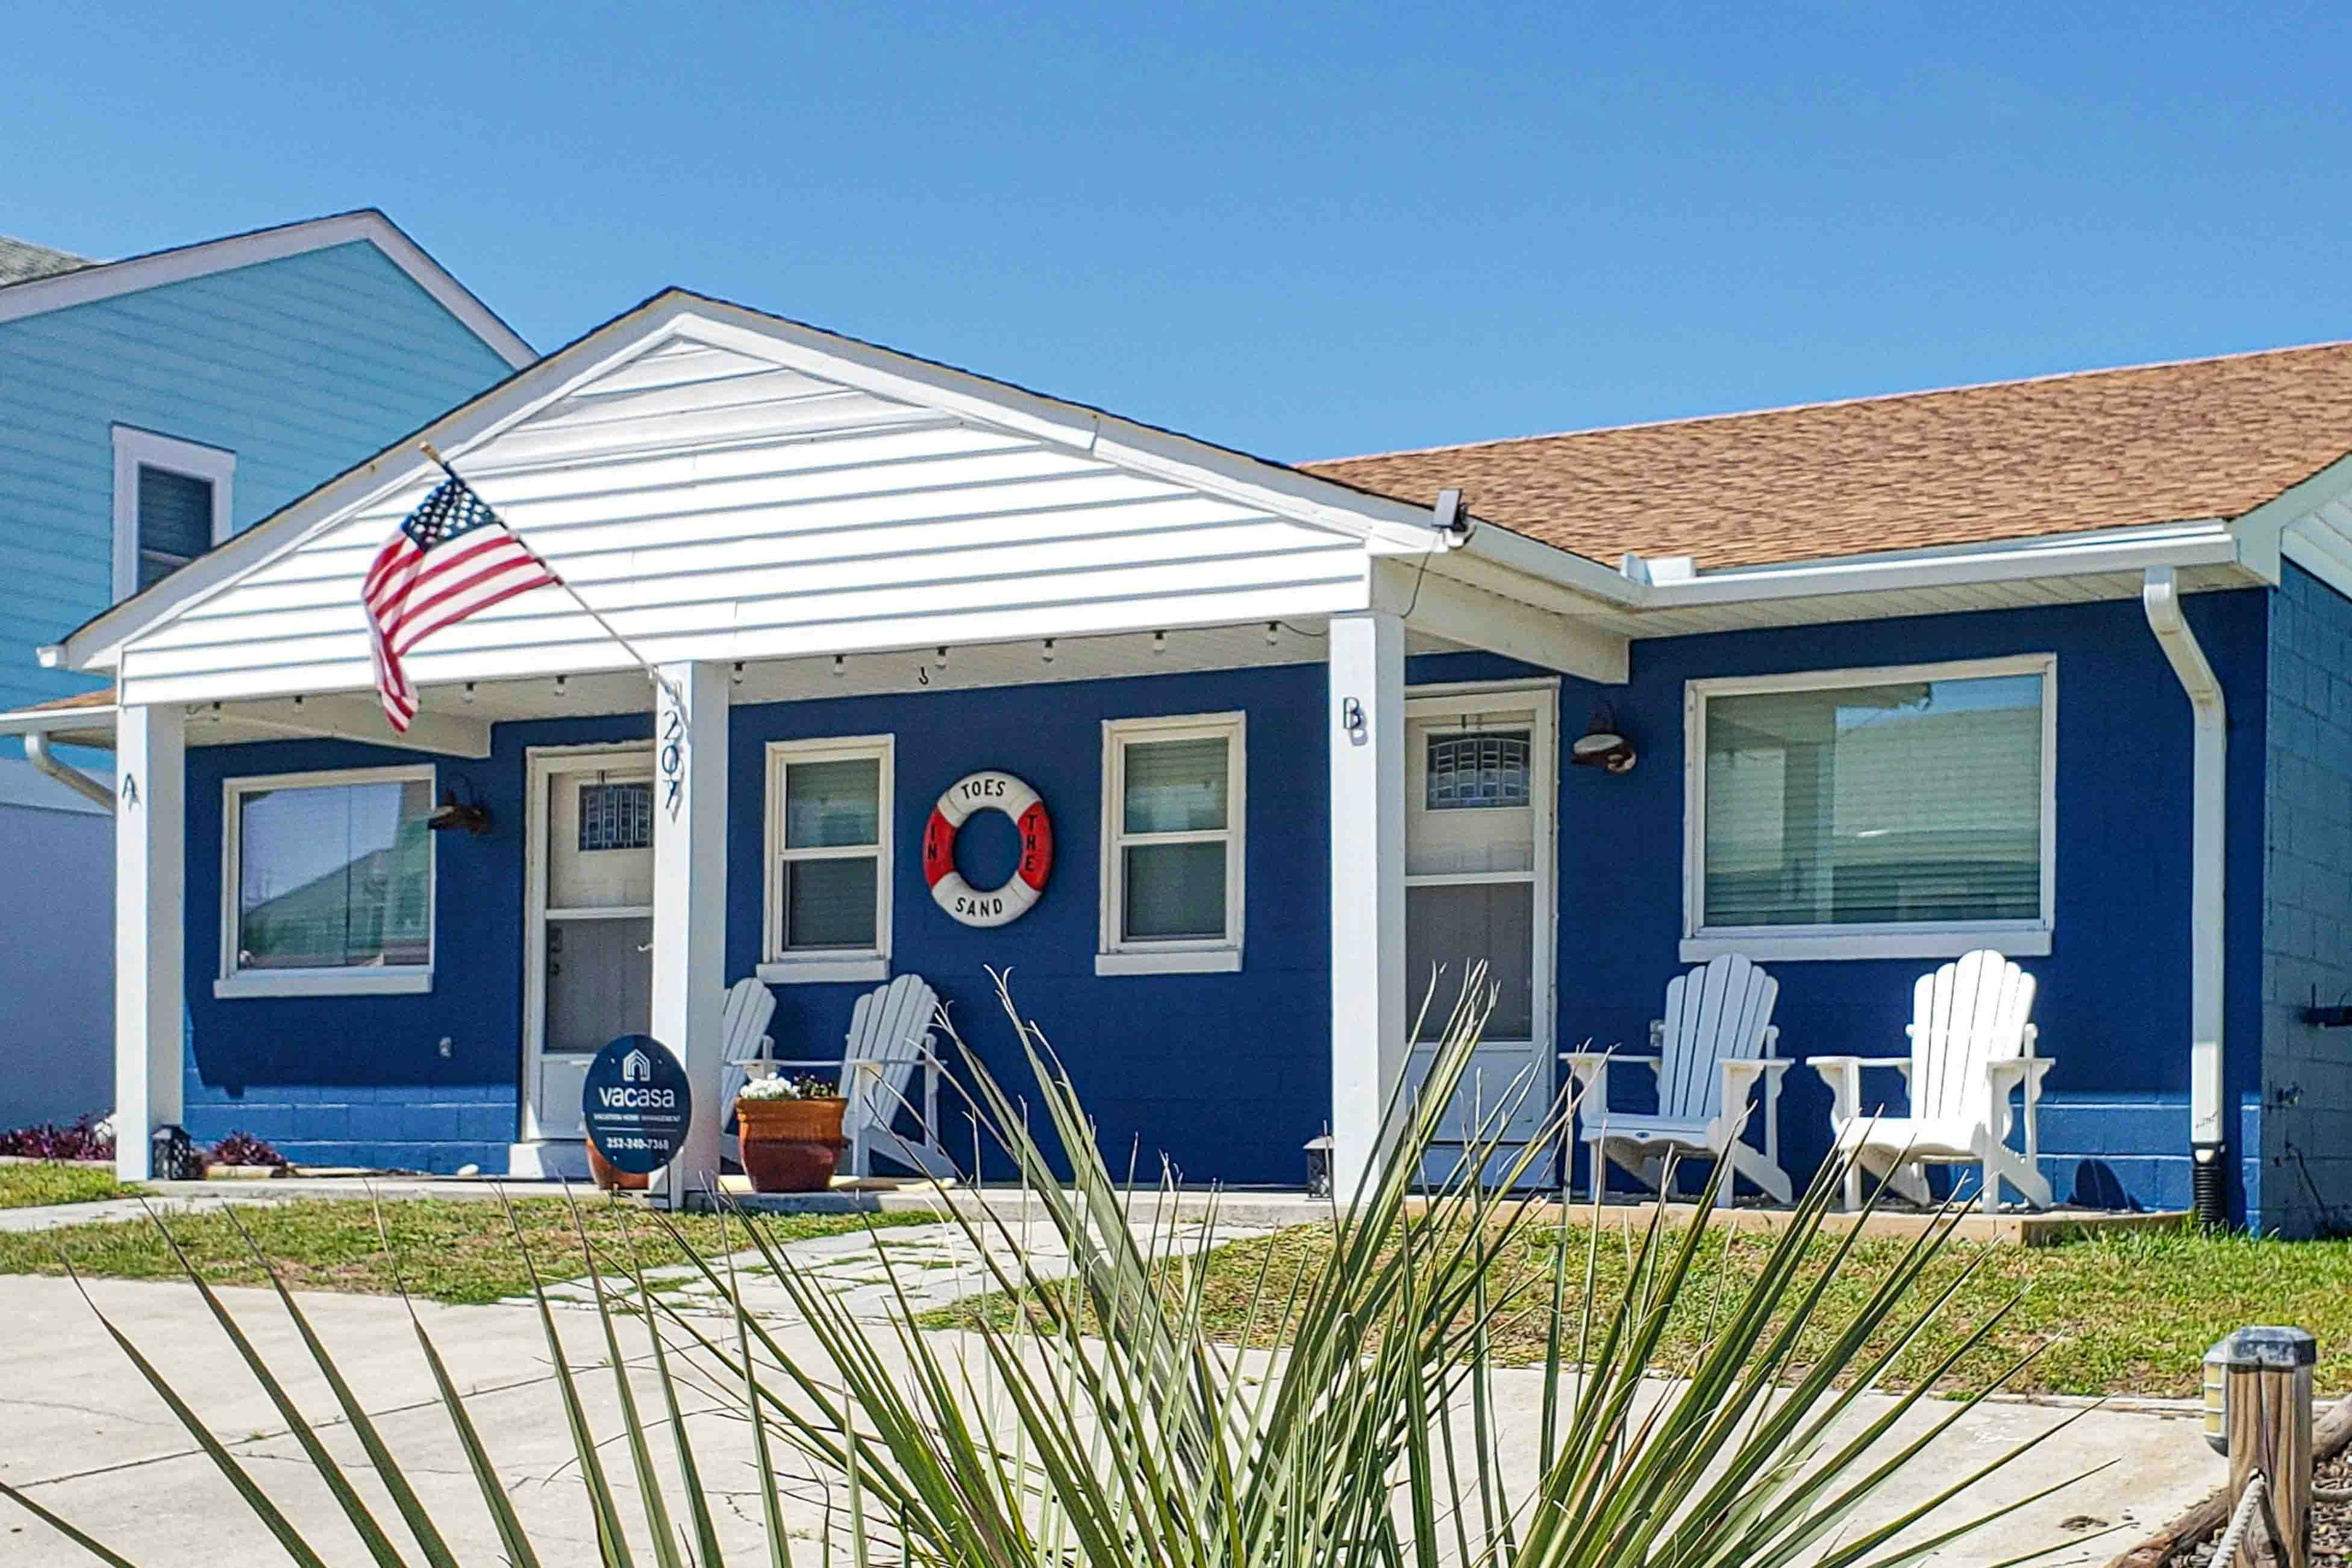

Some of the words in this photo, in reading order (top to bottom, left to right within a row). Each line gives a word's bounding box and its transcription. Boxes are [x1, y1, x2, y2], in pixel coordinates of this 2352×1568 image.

[1343, 697, 1361, 729] B
[122, 773, 136, 800] A
[960, 779, 1006, 800] TOES
[927, 823, 937, 860] IN
[1025, 814, 1038, 872] THE
[955, 896, 1003, 917] SAND
[598, 1087, 675, 1108] vacasa
